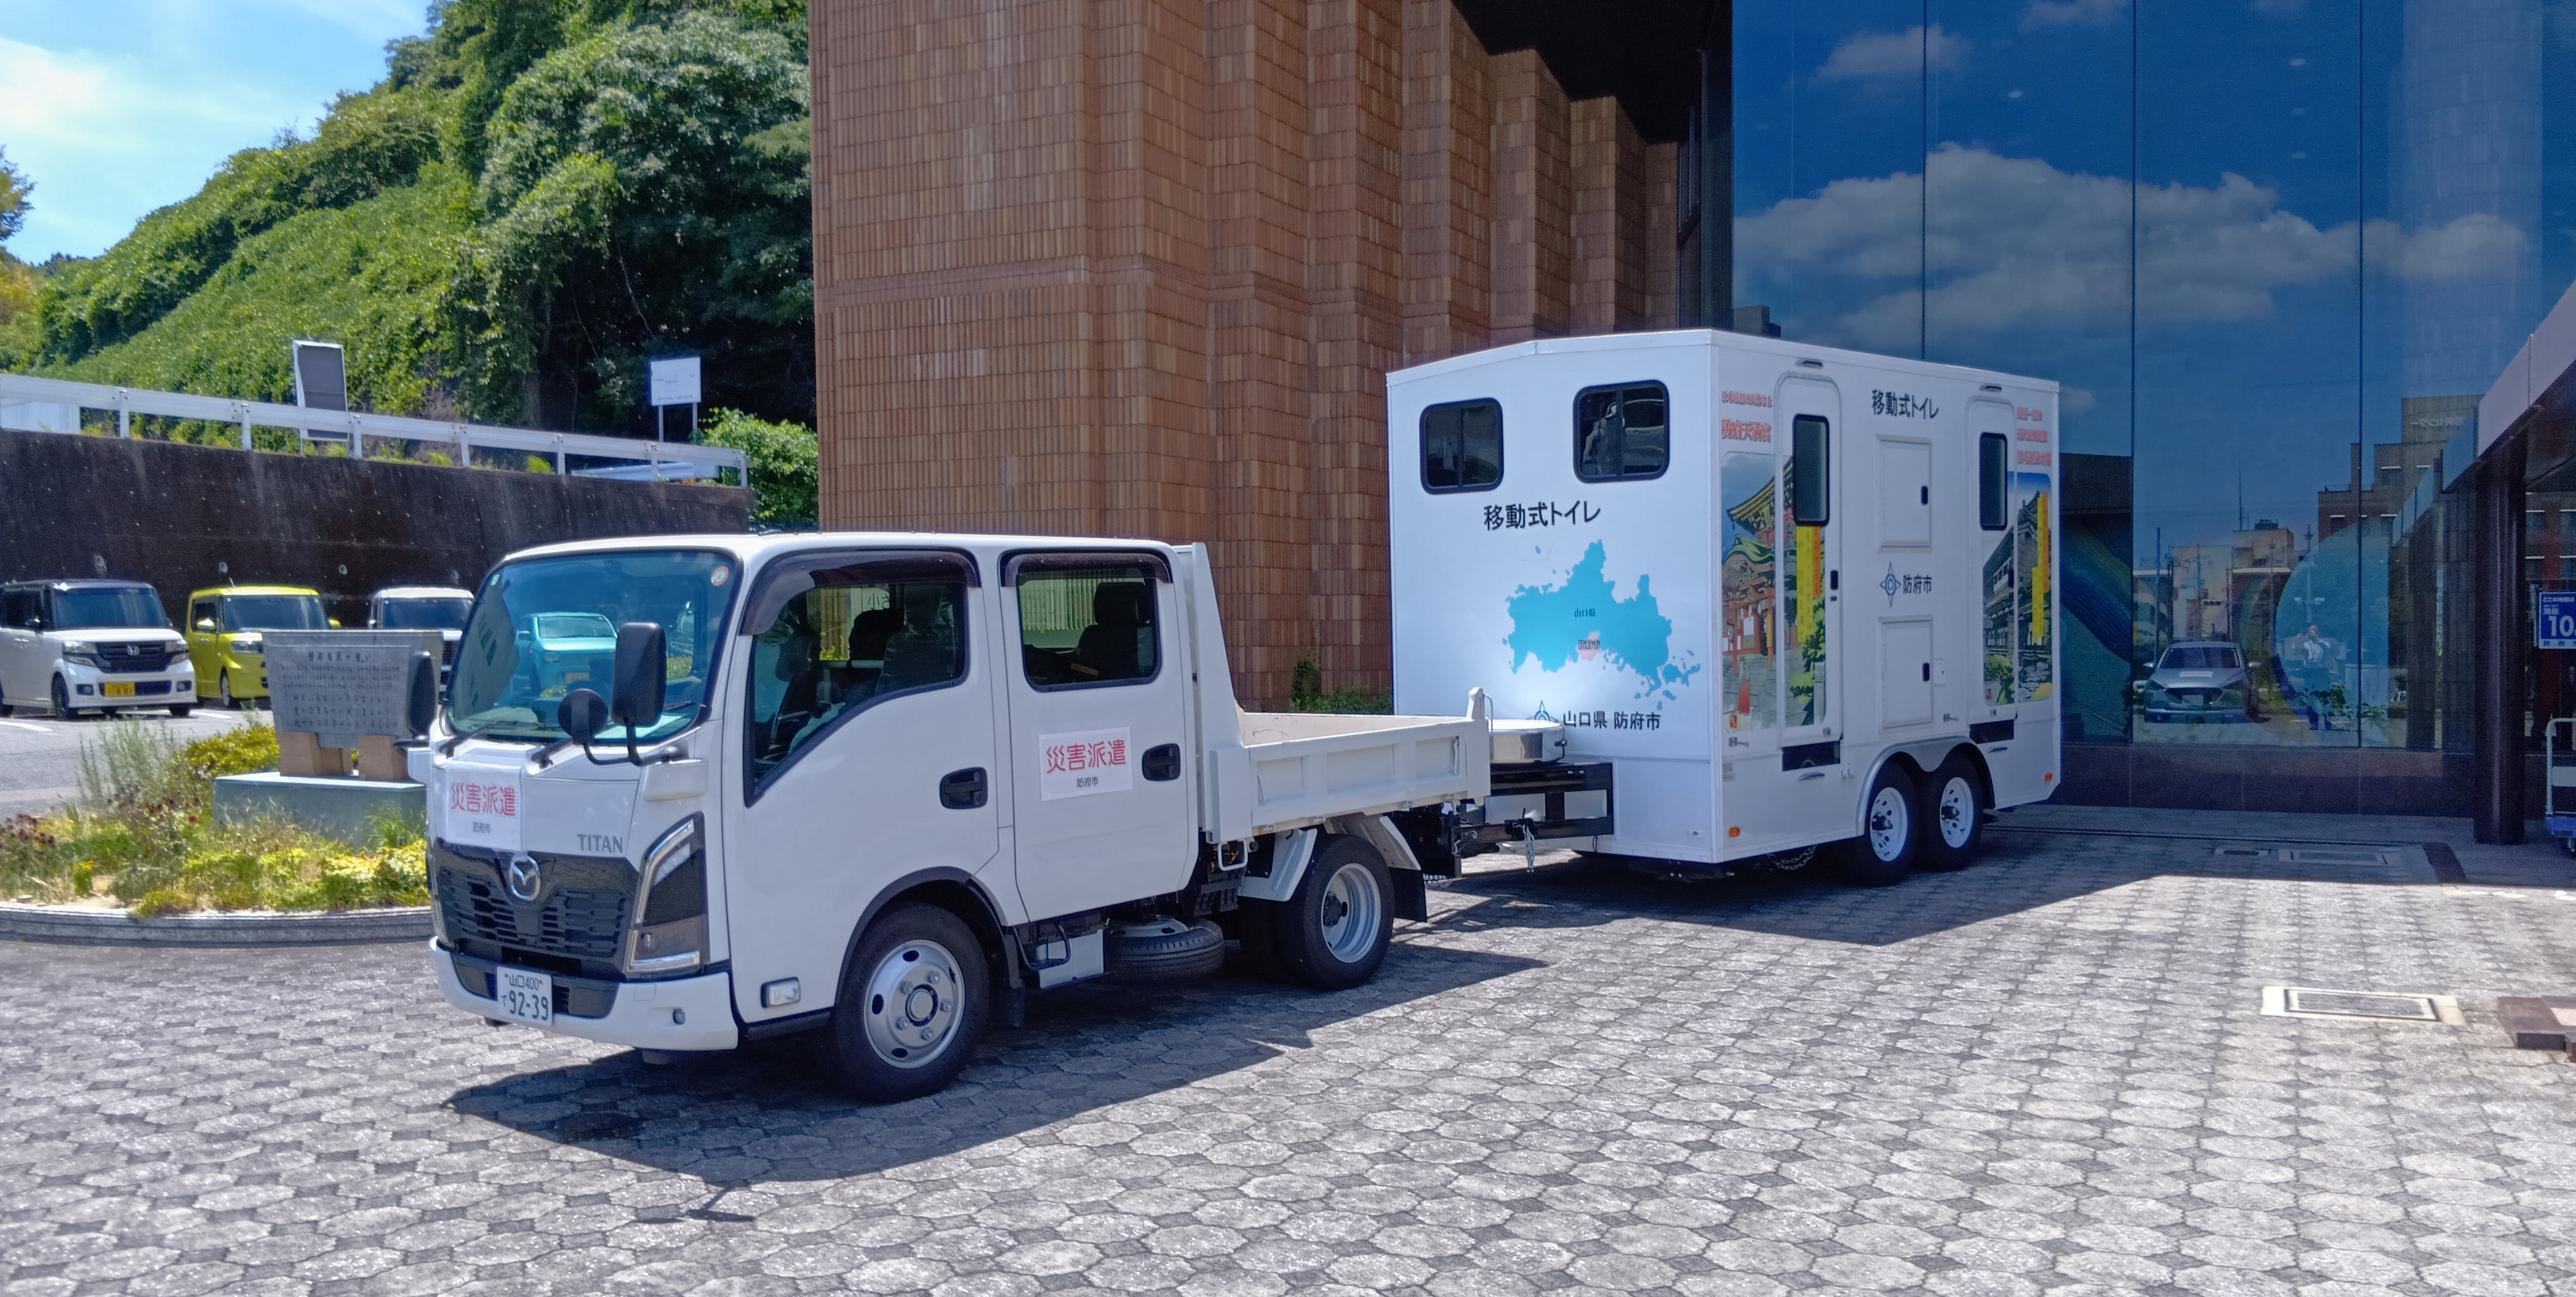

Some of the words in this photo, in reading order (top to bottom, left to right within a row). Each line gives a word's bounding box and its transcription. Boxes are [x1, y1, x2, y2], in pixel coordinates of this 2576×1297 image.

[1871, 389, 1939, 419] 移動式トイレ
[1483, 500, 1601, 530] 移動式トイレ
[1903, 573, 1932, 594] 防府市
[1574, 608, 1596, 617] 山口県
[1577, 639, 1600, 650] 防府市
[1562, 710, 1608, 729] 山口県
[1614, 711, 1661, 730] 防府市
[1046, 739, 1126, 774] 災害派遣
[1076, 776, 1098, 787] 防府市
[450, 781, 516, 817] 災害派遣
[472, 821, 492, 834] 防府市
[577, 833, 623, 854] TITAN
[509, 990, 549, 1021] 92-39
